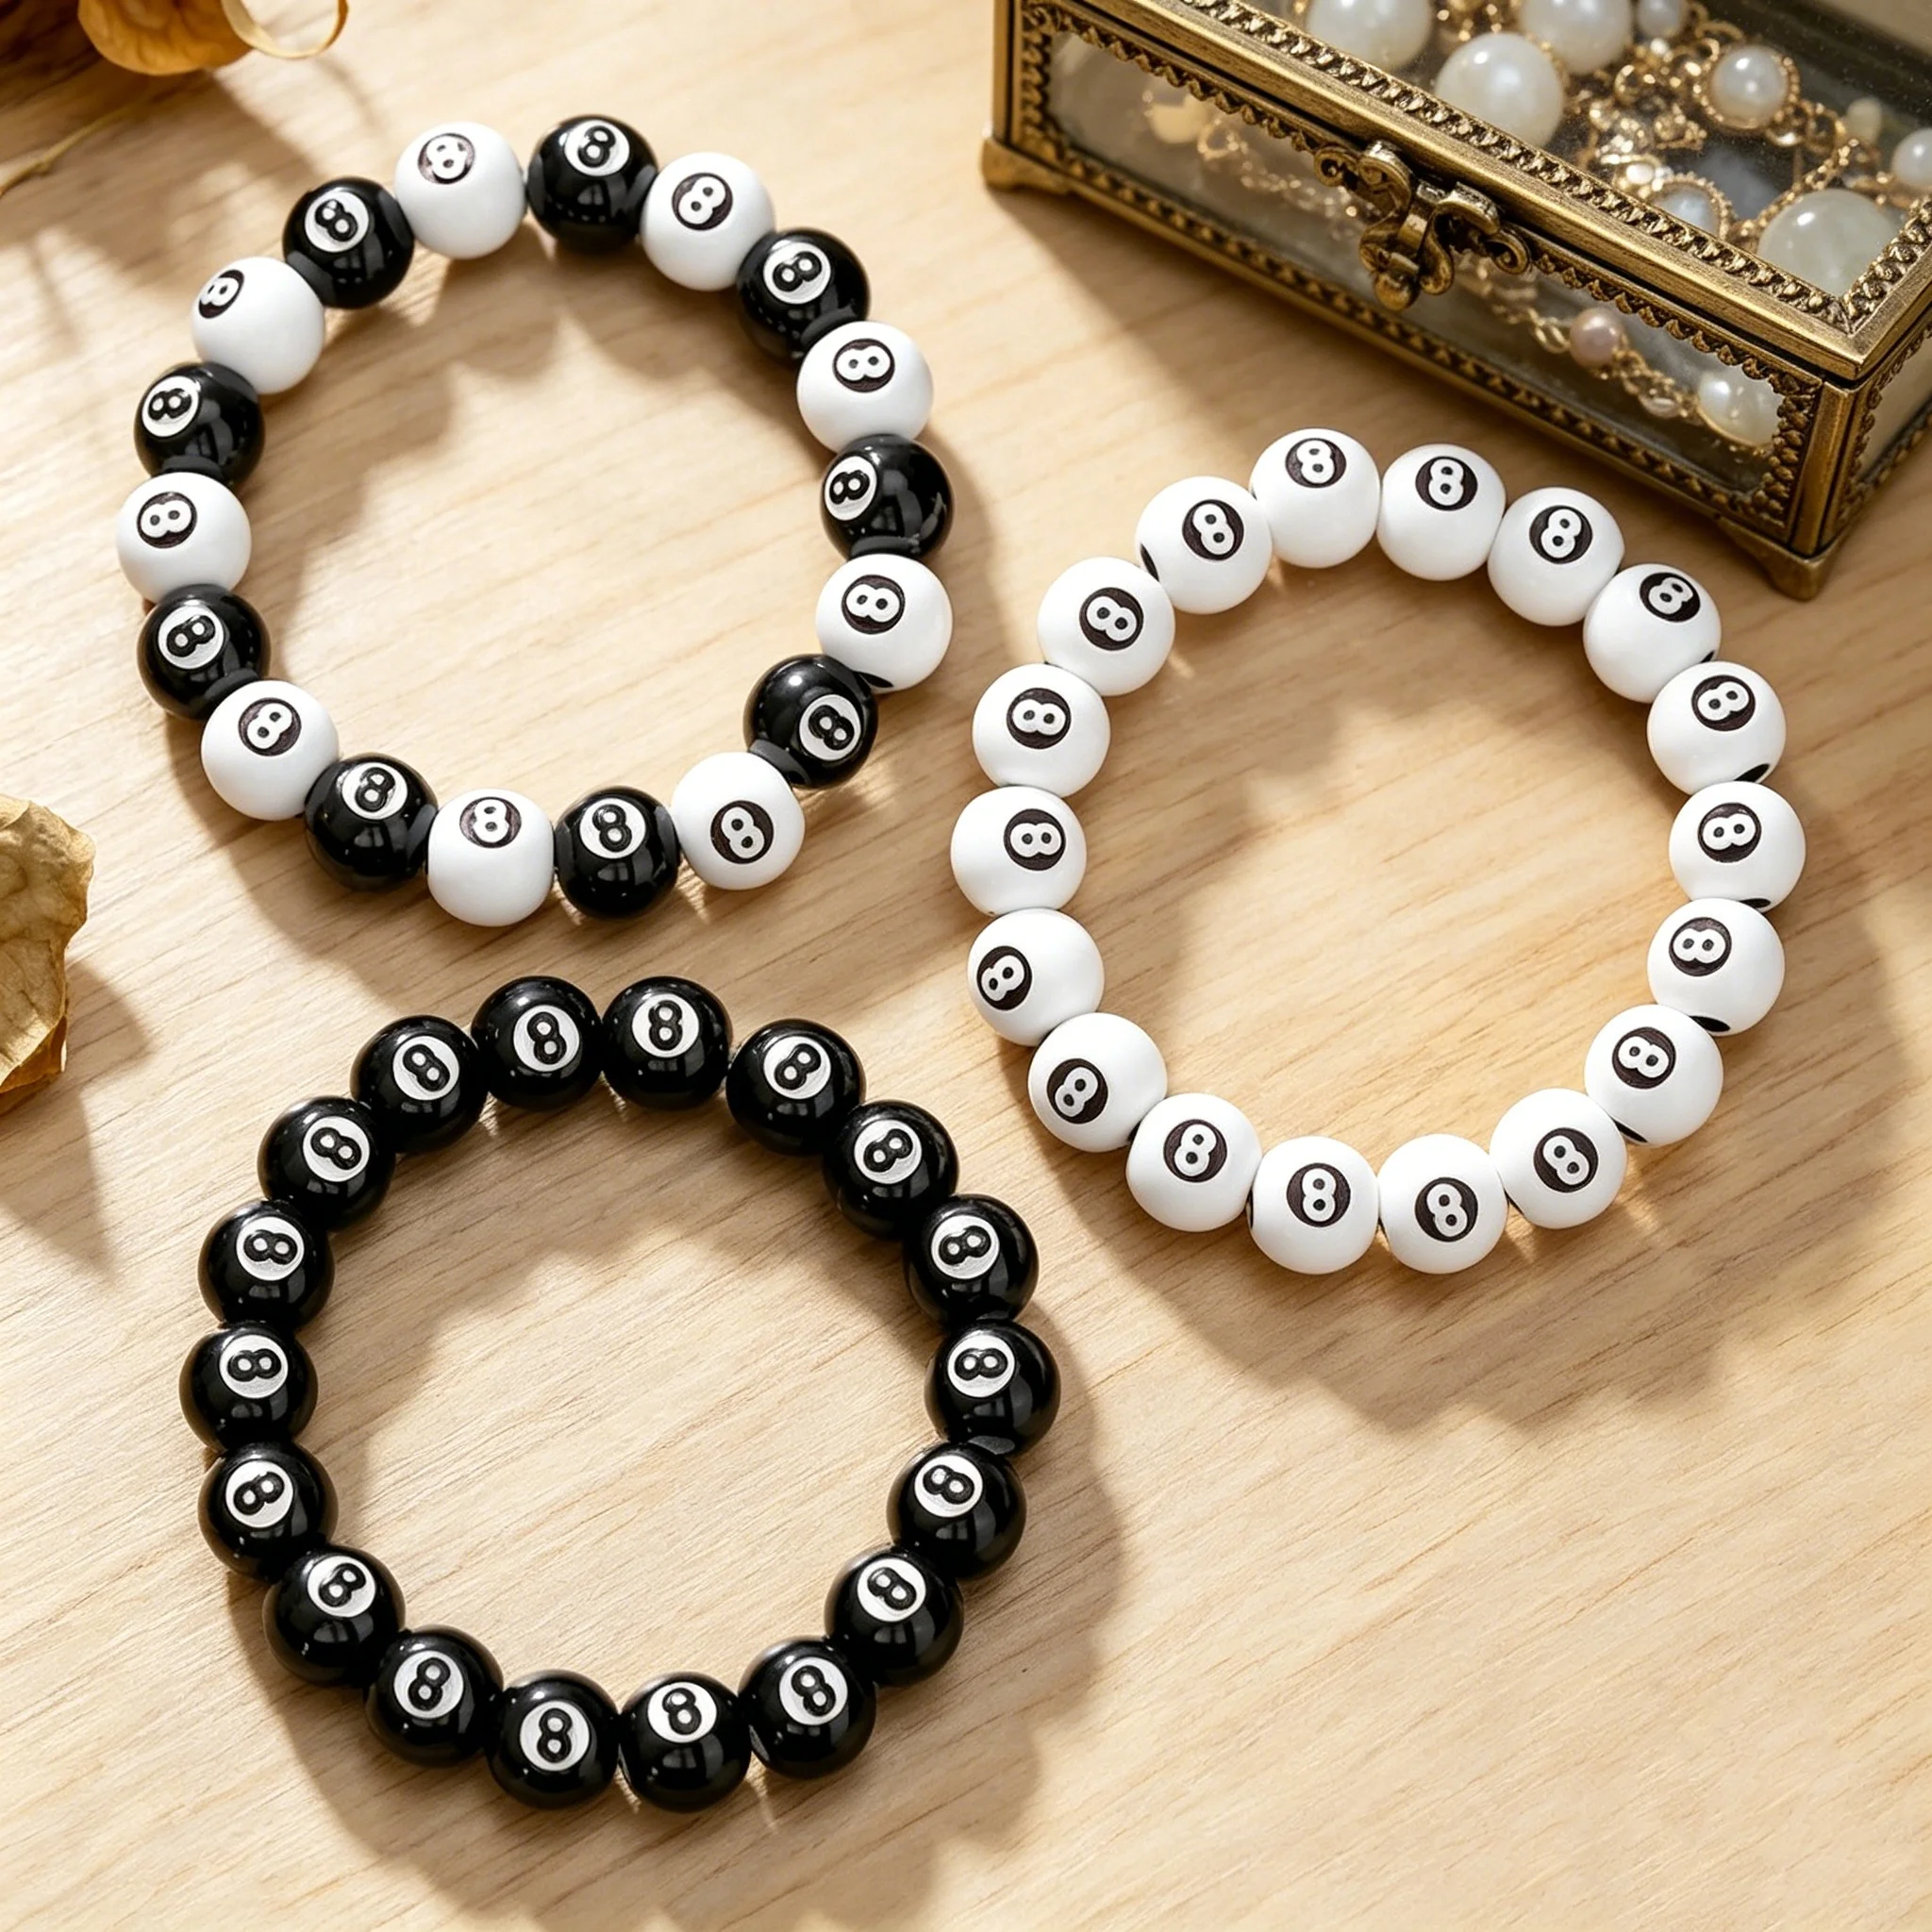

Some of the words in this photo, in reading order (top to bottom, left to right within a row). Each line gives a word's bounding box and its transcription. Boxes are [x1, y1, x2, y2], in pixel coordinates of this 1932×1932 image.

[426, 141, 468, 179] 8
[579, 126, 614, 166] 8
[316, 200, 358, 242] 8
[677, 176, 726, 225] 8
[774, 251, 822, 291] 8
[835, 343, 891, 381] 8
[148, 388, 192, 419] 8
[1296, 439, 1334, 484] 8
[1428, 458, 1463, 505] 8
[831, 470, 868, 504] 8
[140, 500, 192, 537] 8
[1192, 503, 1235, 556] 8
[1541, 508, 1582, 558] 8
[847, 585, 902, 622] 8
[1648, 577, 1693, 614] 8
[167, 615, 216, 656] 8
[1087, 597, 1137, 641] 8
[1012, 699, 1066, 733] 8
[1697, 682, 1749, 720] 8
[245, 703, 293, 749] 8
[808, 704, 854, 749] 8
[355, 768, 394, 811] 8
[475, 799, 510, 843] 8
[592, 805, 632, 852] 8
[724, 807, 762, 858] 8
[1009, 824, 1060, 856] 8
[1702, 813, 1757, 849] 8
[1674, 928, 1726, 962] 8
[981, 957, 1025, 1001] 8
[527, 1011, 566, 1063] 8
[648, 1000, 683, 1051] 8
[402, 1044, 450, 1091] 8
[774, 1044, 821, 1088] 8
[1618, 1035, 1669, 1079] 8
[1055, 1067, 1099, 1116] 8
[311, 1127, 362, 1170] 8
[862, 1128, 911, 1172] 8
[1174, 1124, 1216, 1176] 8
[1542, 1135, 1590, 1185] 8
[1303, 1168, 1337, 1222] 8
[1427, 1183, 1467, 1237] 8
[242, 1230, 297, 1264] 8
[940, 1225, 991, 1264] 8
[228, 1349, 281, 1381] 8
[955, 1348, 1008, 1381] 8
[234, 1472, 284, 1515] 8
[923, 1465, 974, 1503] 8
[319, 1562, 365, 1607] 8
[868, 1568, 916, 1610] 8
[408, 1658, 450, 1710] 8
[791, 1665, 834, 1716] 8
[662, 1688, 702, 1735] 8
[537, 1707, 573, 1763] 8
